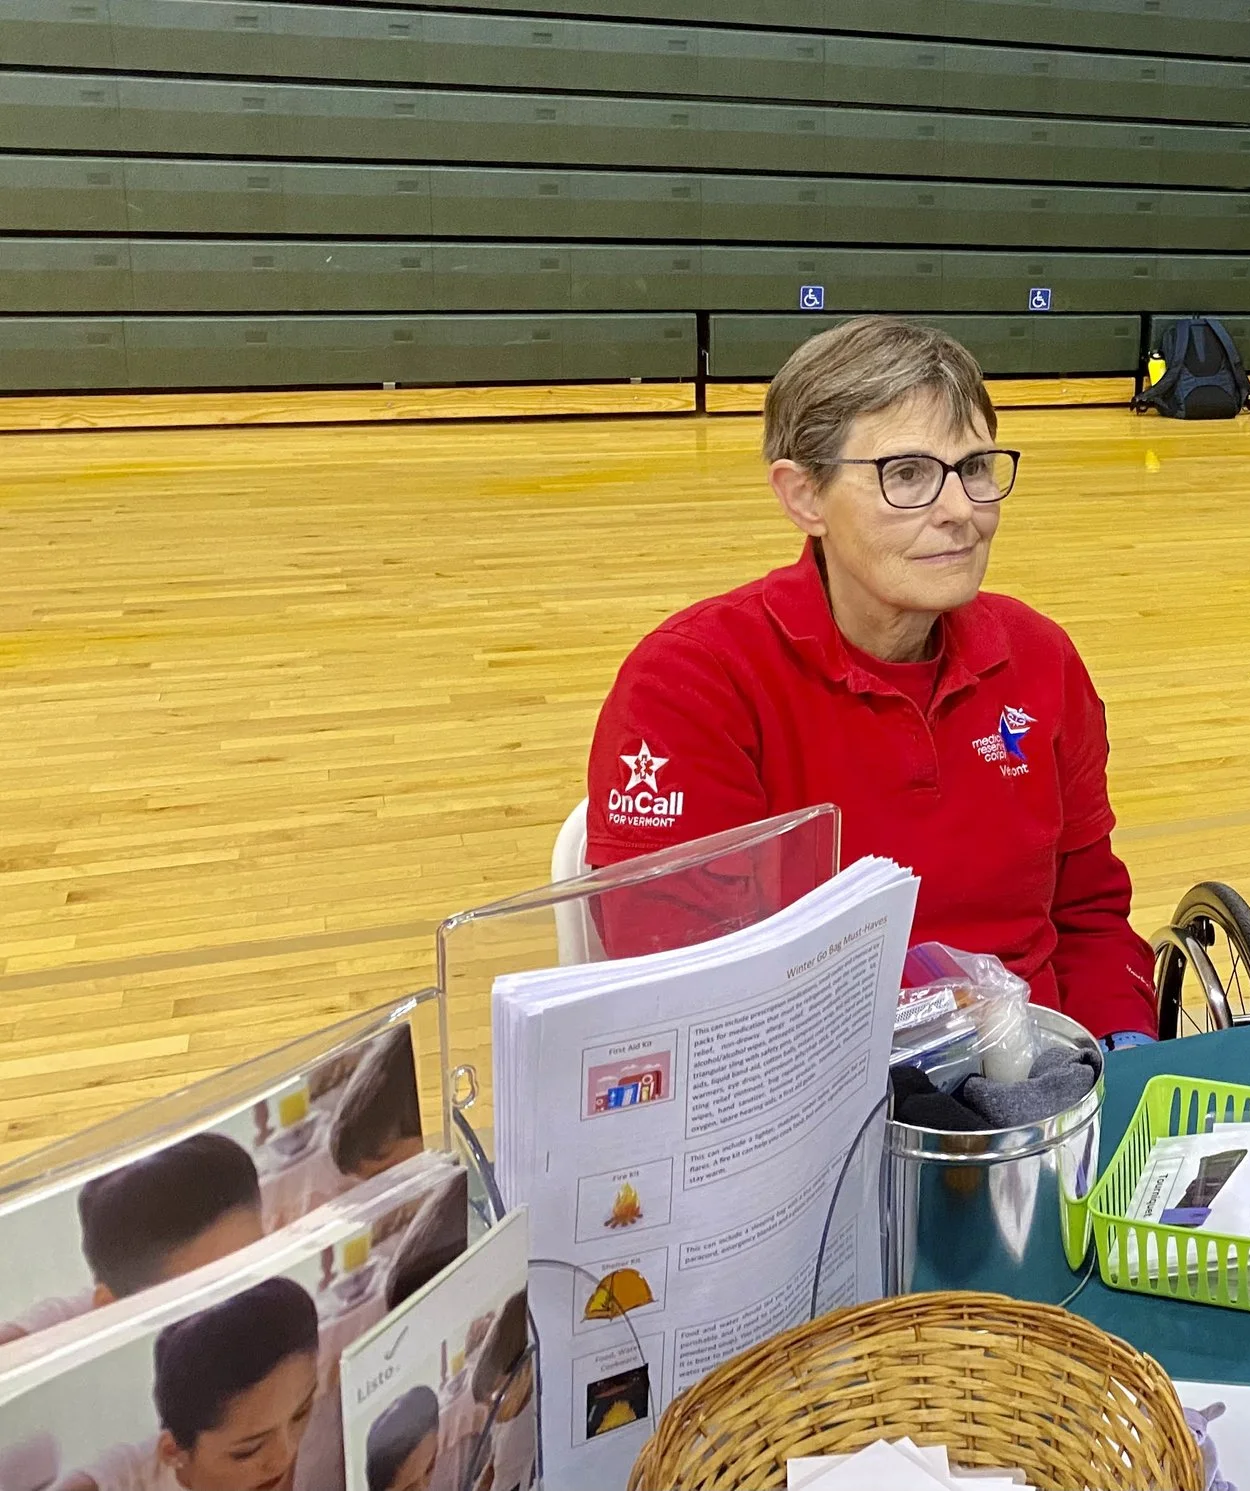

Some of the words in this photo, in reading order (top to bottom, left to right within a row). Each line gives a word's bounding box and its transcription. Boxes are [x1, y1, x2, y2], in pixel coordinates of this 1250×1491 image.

[608, 788, 684, 816] OnCall
[609, 813, 627, 825] FOR
[628, 816, 676, 828] VERMONT
[786, 958, 816, 980] Winter
[816, 950, 828, 963] Go
[829, 940, 842, 957] Bag
[843, 914, 889, 946] Must-Haves
[693, 1035, 713, 1048] packs
[715, 1031, 726, 1041] for
[728, 1018, 765, 1037] medication
[766, 1012, 780, 1023] that
[694, 1026, 709, 1036] This
[710, 1023, 723, 1032] can
[724, 1014, 749, 1028] include
[608, 1044, 627, 1057] First
[628, 1041, 641, 1053] Aid
[641, 1038, 653, 1050] Kit
[745, 1051, 759, 1063] with
[717, 1102, 734, 1115] hand
[690, 1152, 704, 1162] This
[707, 1148, 719, 1158] can
[612, 1173, 627, 1183] Fire
[689, 1174, 703, 1184] stay
[1143, 1173, 1169, 1218] Tourniquet
